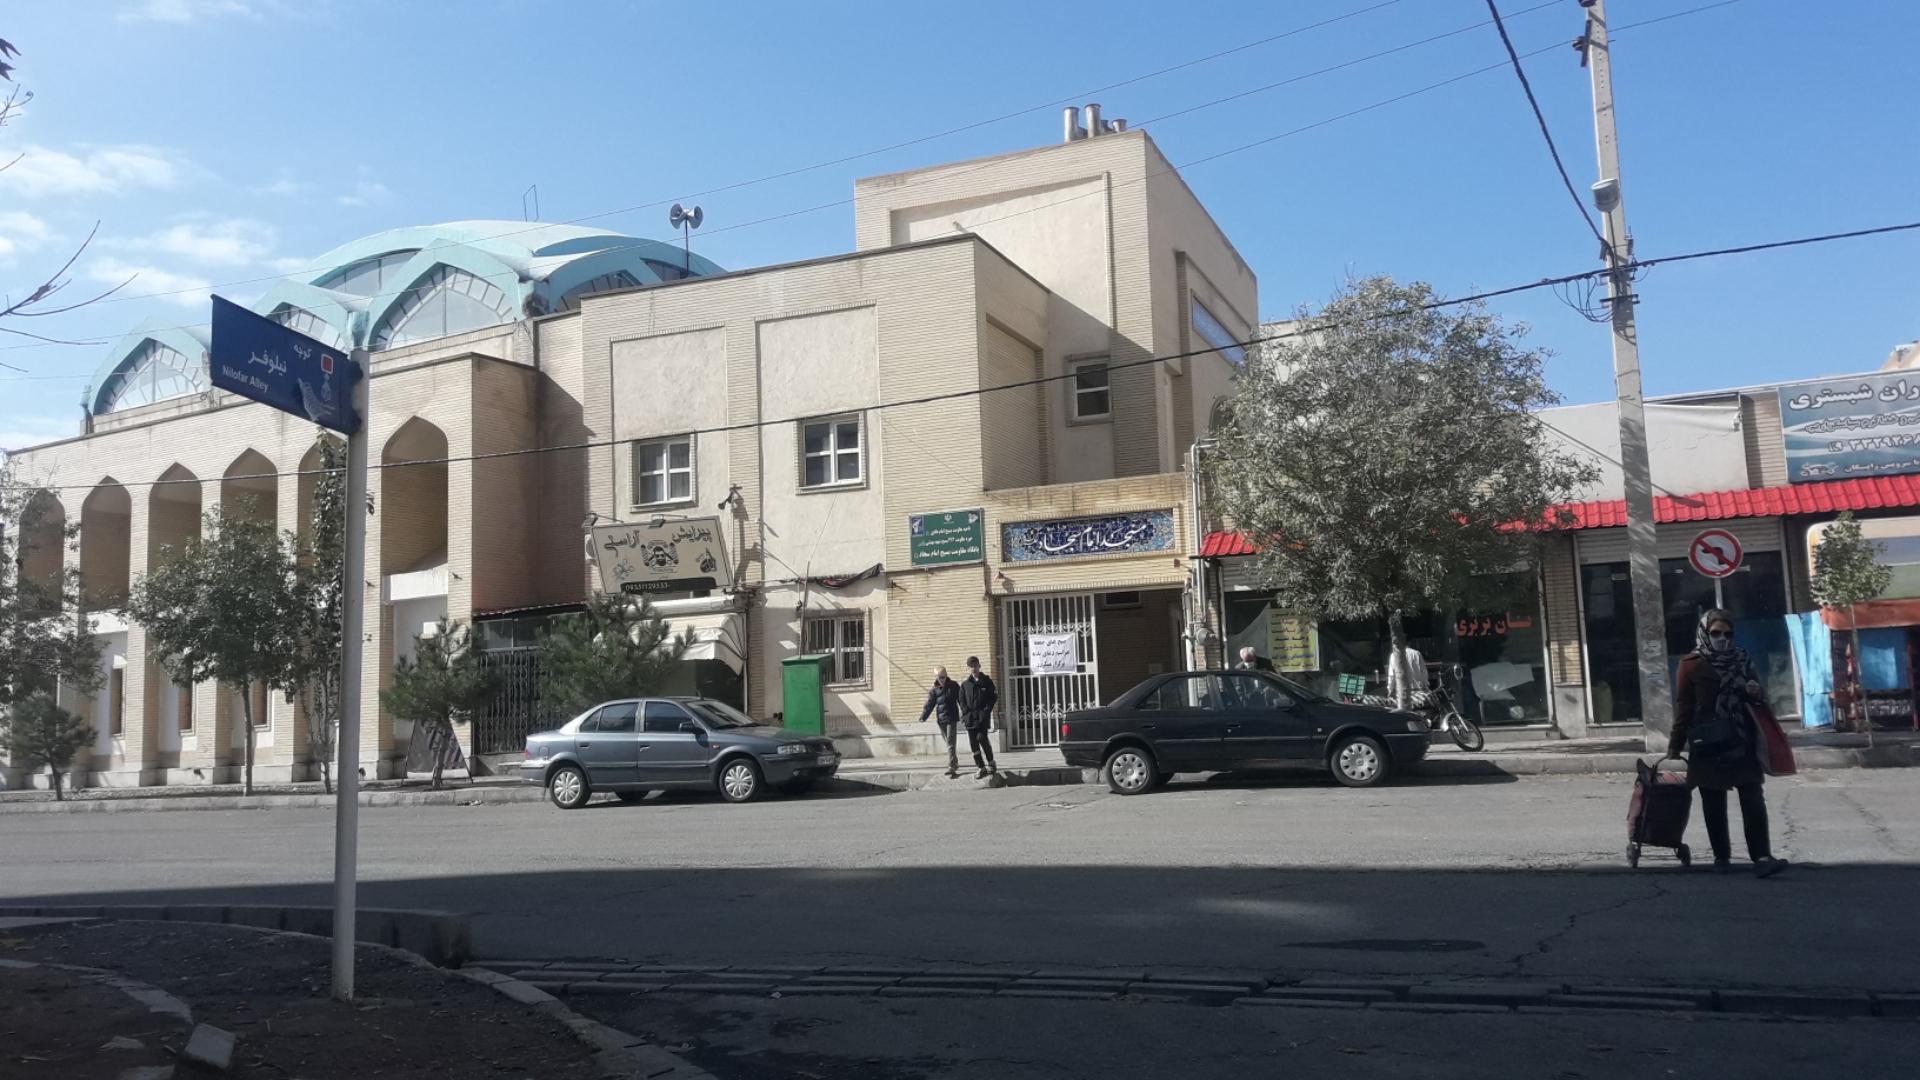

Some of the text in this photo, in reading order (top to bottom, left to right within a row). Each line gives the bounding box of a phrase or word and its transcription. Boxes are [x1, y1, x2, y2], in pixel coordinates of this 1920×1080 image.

[248, 349, 287, 377] نیلوفر
[293, 344, 312, 361] کوچه
[222, 364, 269, 393] Nilofar Alley
[1789, 383, 1874, 410] شبستری
[672, 525, 712, 544] پیرایش
[1038, 530, 1082, 552] سجاد
[1102, 523, 1146, 548] مسجد
